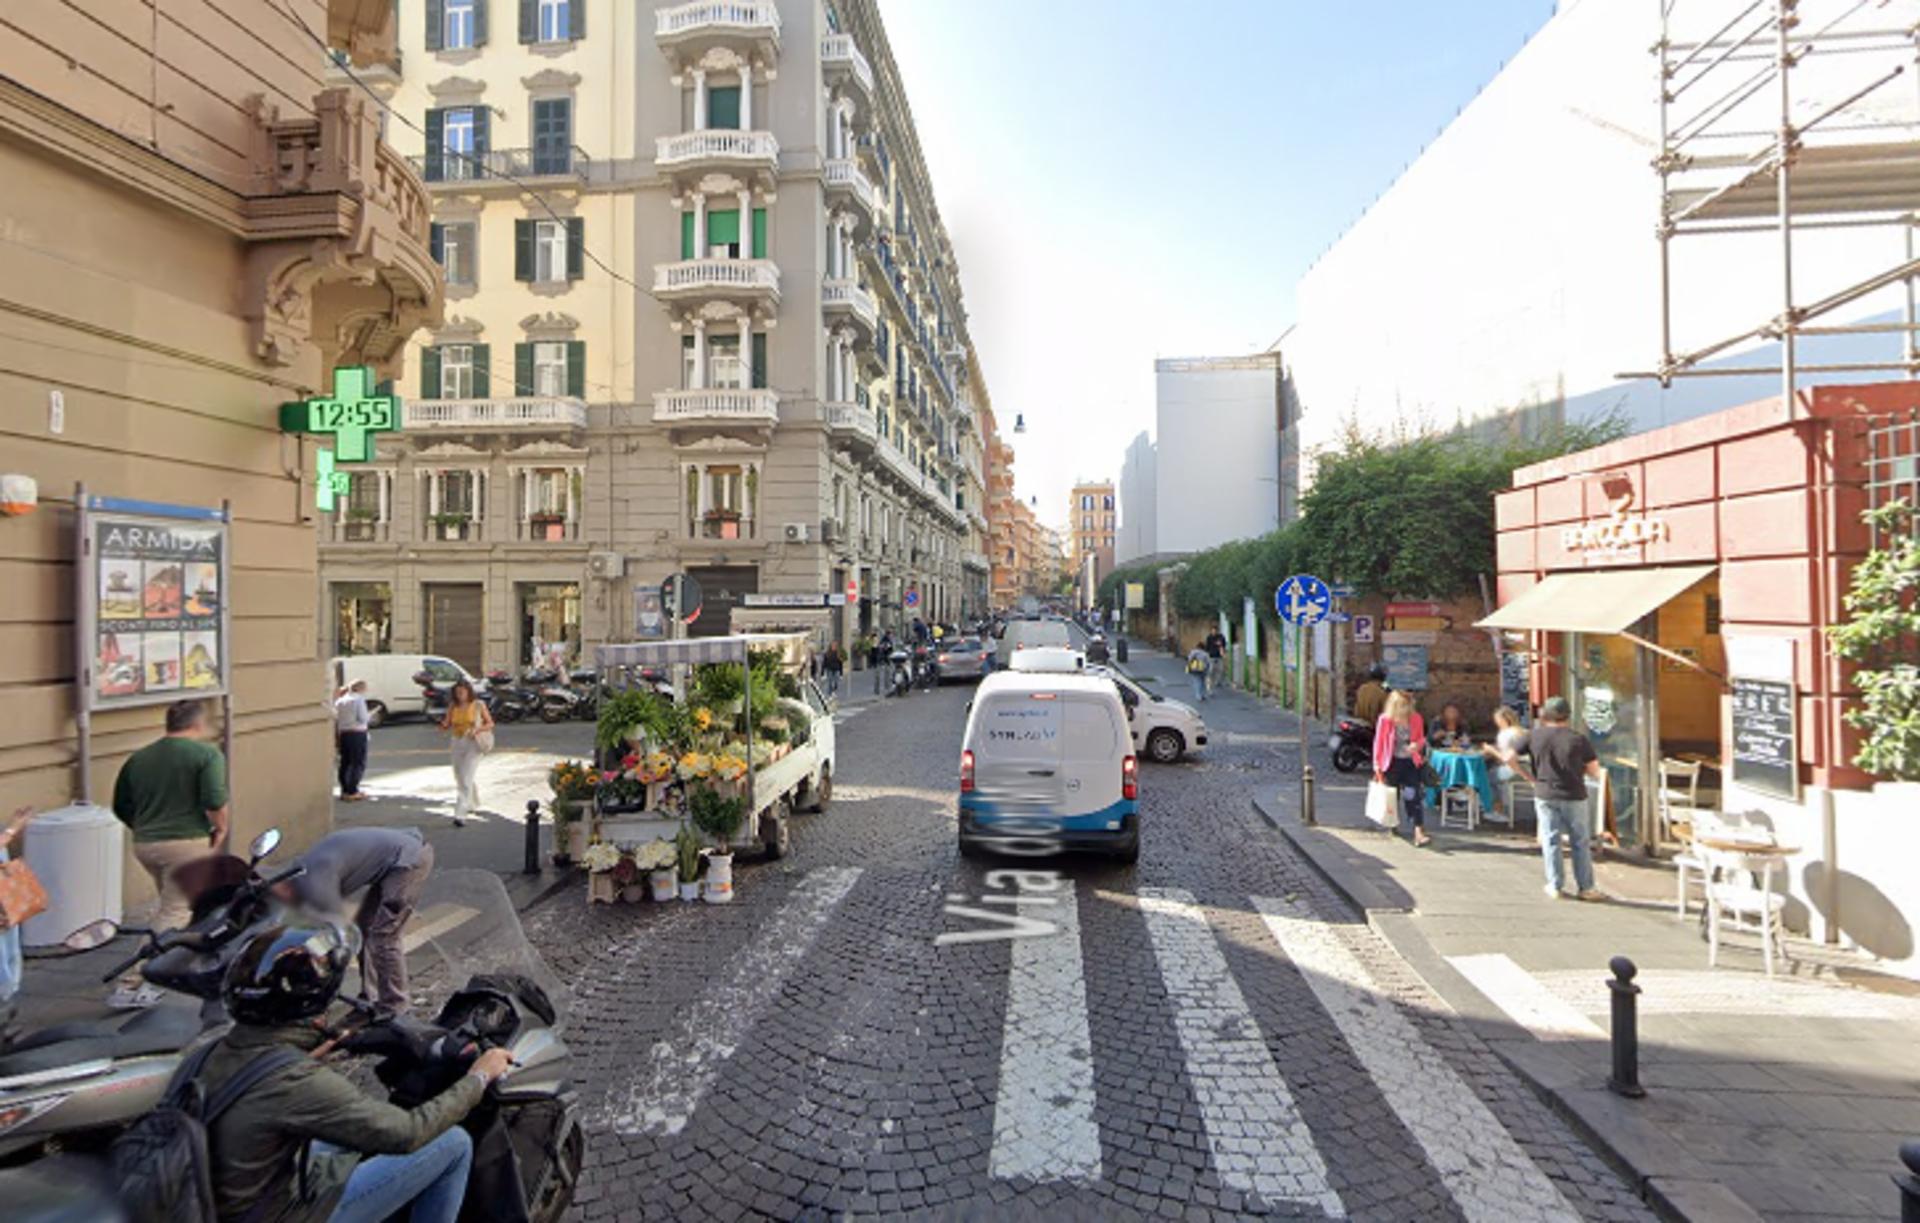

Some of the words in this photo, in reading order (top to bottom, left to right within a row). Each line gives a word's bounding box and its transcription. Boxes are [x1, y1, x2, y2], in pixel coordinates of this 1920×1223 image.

[315, 401, 388, 427] 12:55
[105, 527, 215, 552] ARMIDA
[1356, 617, 1371, 634] P
